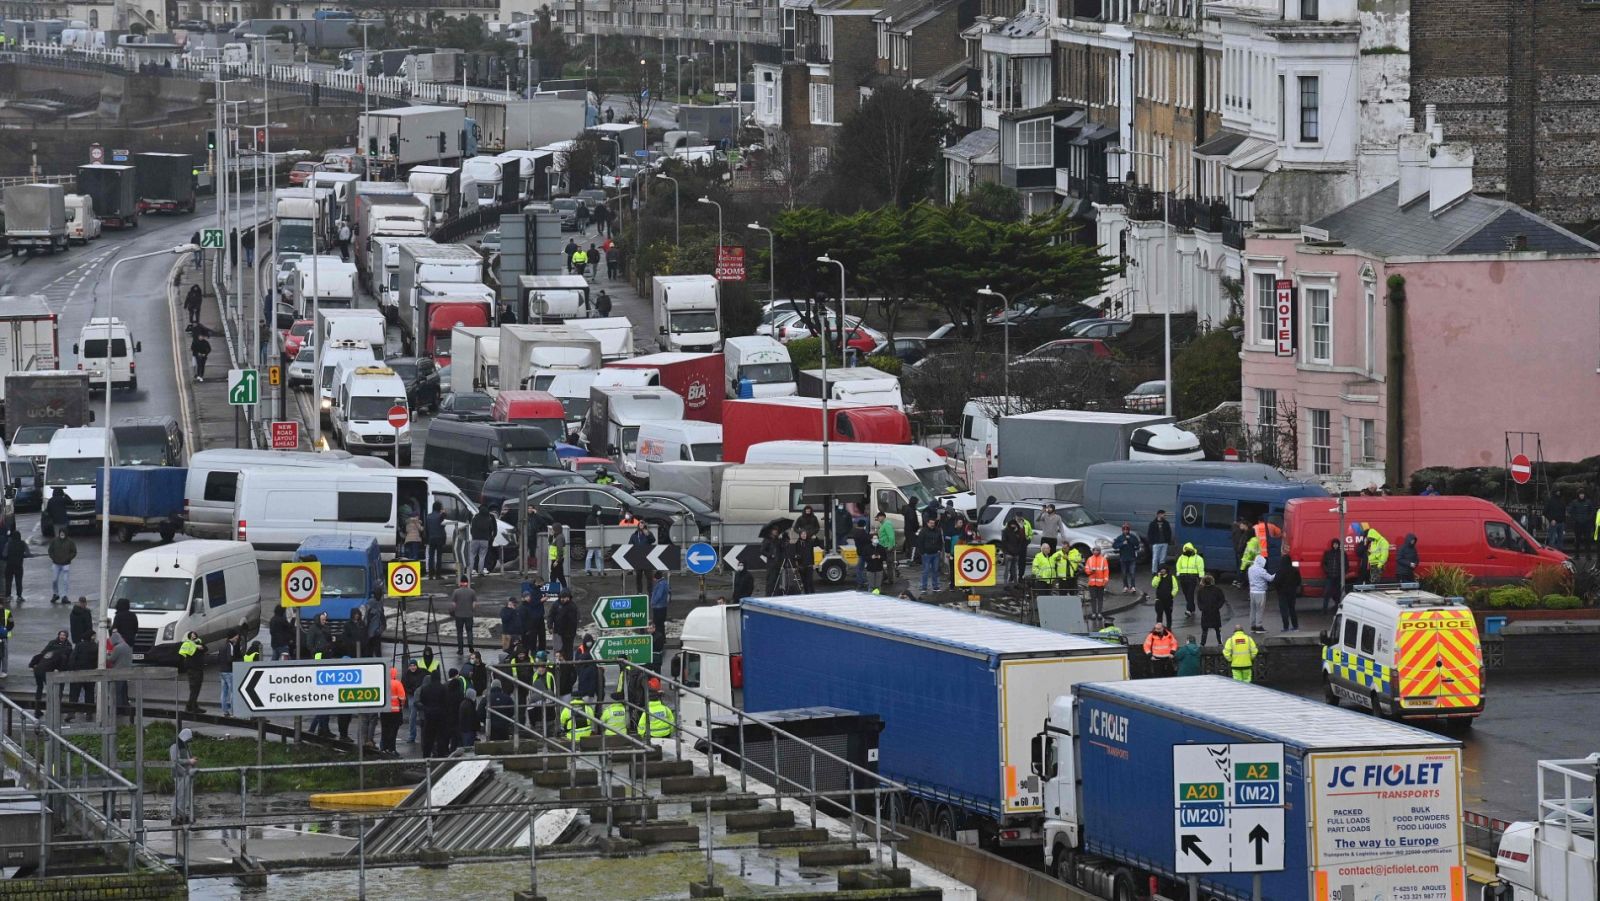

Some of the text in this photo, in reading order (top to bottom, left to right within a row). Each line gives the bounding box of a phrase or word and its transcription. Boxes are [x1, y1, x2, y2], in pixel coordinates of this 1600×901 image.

[715, 267, 745, 275] ROOMS
[1279, 292, 1290, 353] HOTEL
[963, 558, 987, 573] 30
[290, 576, 313, 592] 30
[395, 573, 414, 585] 30
[611, 600, 630, 609] (M2)
[610, 611, 646, 620] Canterbury
[1401, 620, 1472, 630] POLICE
[607, 648, 640, 657] Ramsgate
[269, 673, 312, 685] London
[269, 691, 334, 704] Folkestone
[1334, 684, 1370, 707] POLICE
[1089, 708, 1129, 744] JC FIOLET
[1246, 765, 1268, 779] A2
[1327, 765, 1356, 788] JC
[1363, 763, 1443, 787] FIOLET
[1186, 785, 1218, 799] A20
[1240, 784, 1275, 802] (M2)
[1375, 789, 1440, 800] TRANSPORTS
[1032, 796, 1039, 805] 70
[1181, 804, 1224, 825] (M20)
[1333, 808, 1363, 816] PACKED
[1411, 806, 1431, 814] BULK
[1327, 817, 1343, 825] FULL
[1414, 814, 1450, 822] POWDERS
[1327, 825, 1371, 834] PART LOADS
[1418, 823, 1447, 831] LIQUIDS
[1335, 837, 1440, 850] The way to Europe
[1338, 864, 1440, 878] contact@jcfiolet.com
[1421, 884, 1446, 892] ARQUES
[1436, 891, 1447, 899] 777
